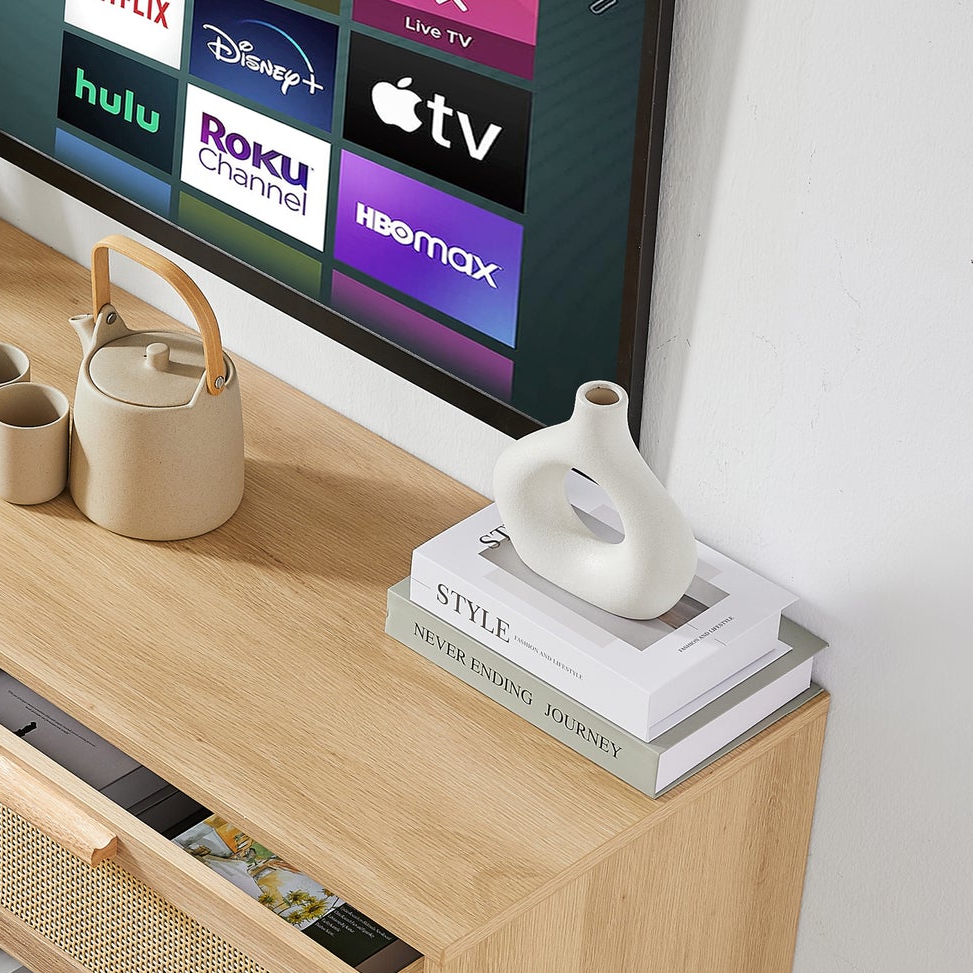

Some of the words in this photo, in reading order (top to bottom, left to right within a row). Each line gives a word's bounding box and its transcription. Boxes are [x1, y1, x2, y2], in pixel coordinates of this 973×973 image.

[404, 16, 441, 39] Live
[447, 29, 473, 48] TV
[75, 67, 160, 133] hulu
[198, 147, 307, 216] Channel
[436, 583, 511, 644] STYLE
[514, 635, 539, 653] FASHION
[539, 651, 552, 661] AND
[552, 658, 583, 680] LIFESTYLE
[678, 637, 700, 653] FASHION
[698, 631, 710, 640] AND
[413, 621, 467, 666] NEVER
[470, 655, 534, 706] ENDING
[544, 702, 623, 760] JOURNEY
